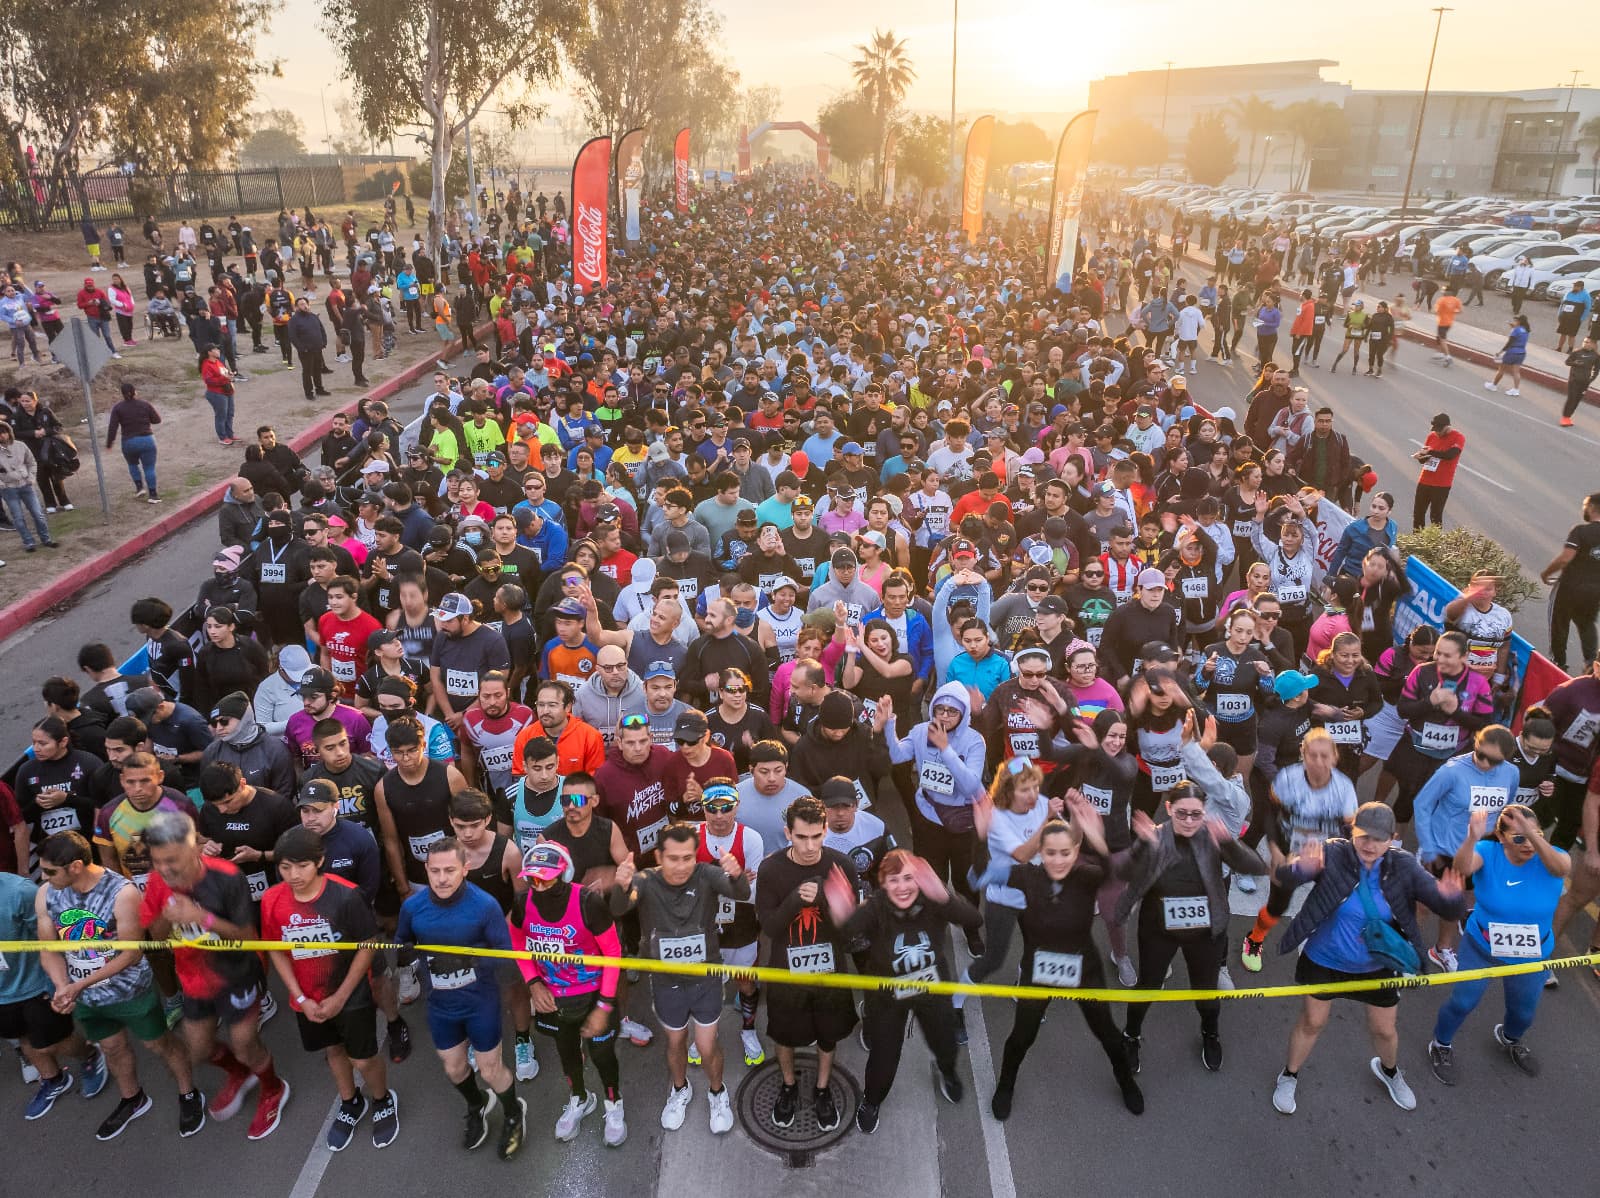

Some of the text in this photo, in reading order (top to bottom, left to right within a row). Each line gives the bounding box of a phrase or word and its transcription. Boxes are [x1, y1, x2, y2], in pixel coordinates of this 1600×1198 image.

[578, 200, 603, 282] Coca-Cola
[263, 568, 284, 577] 3994
[679, 583, 696, 593] 470
[1280, 591, 1304, 601] 3763
[448, 677, 474, 689] 0521
[1219, 701, 1246, 710] 1031
[1329, 725, 1358, 735] 3304
[1425, 732, 1454, 742] 4441
[922, 769, 952, 785] 4322
[1155, 774, 1182, 785] 0991
[627, 789, 665, 824] MASTER
[1081, 792, 1108, 808] 986
[1473, 795, 1504, 807] 2066
[43, 815, 74, 830] 2227
[1168, 906, 1206, 919] 1338
[528, 938, 560, 953] 3062
[1494, 933, 1537, 947] 2125
[664, 945, 703, 959] 2684
[792, 952, 830, 968] 0773
